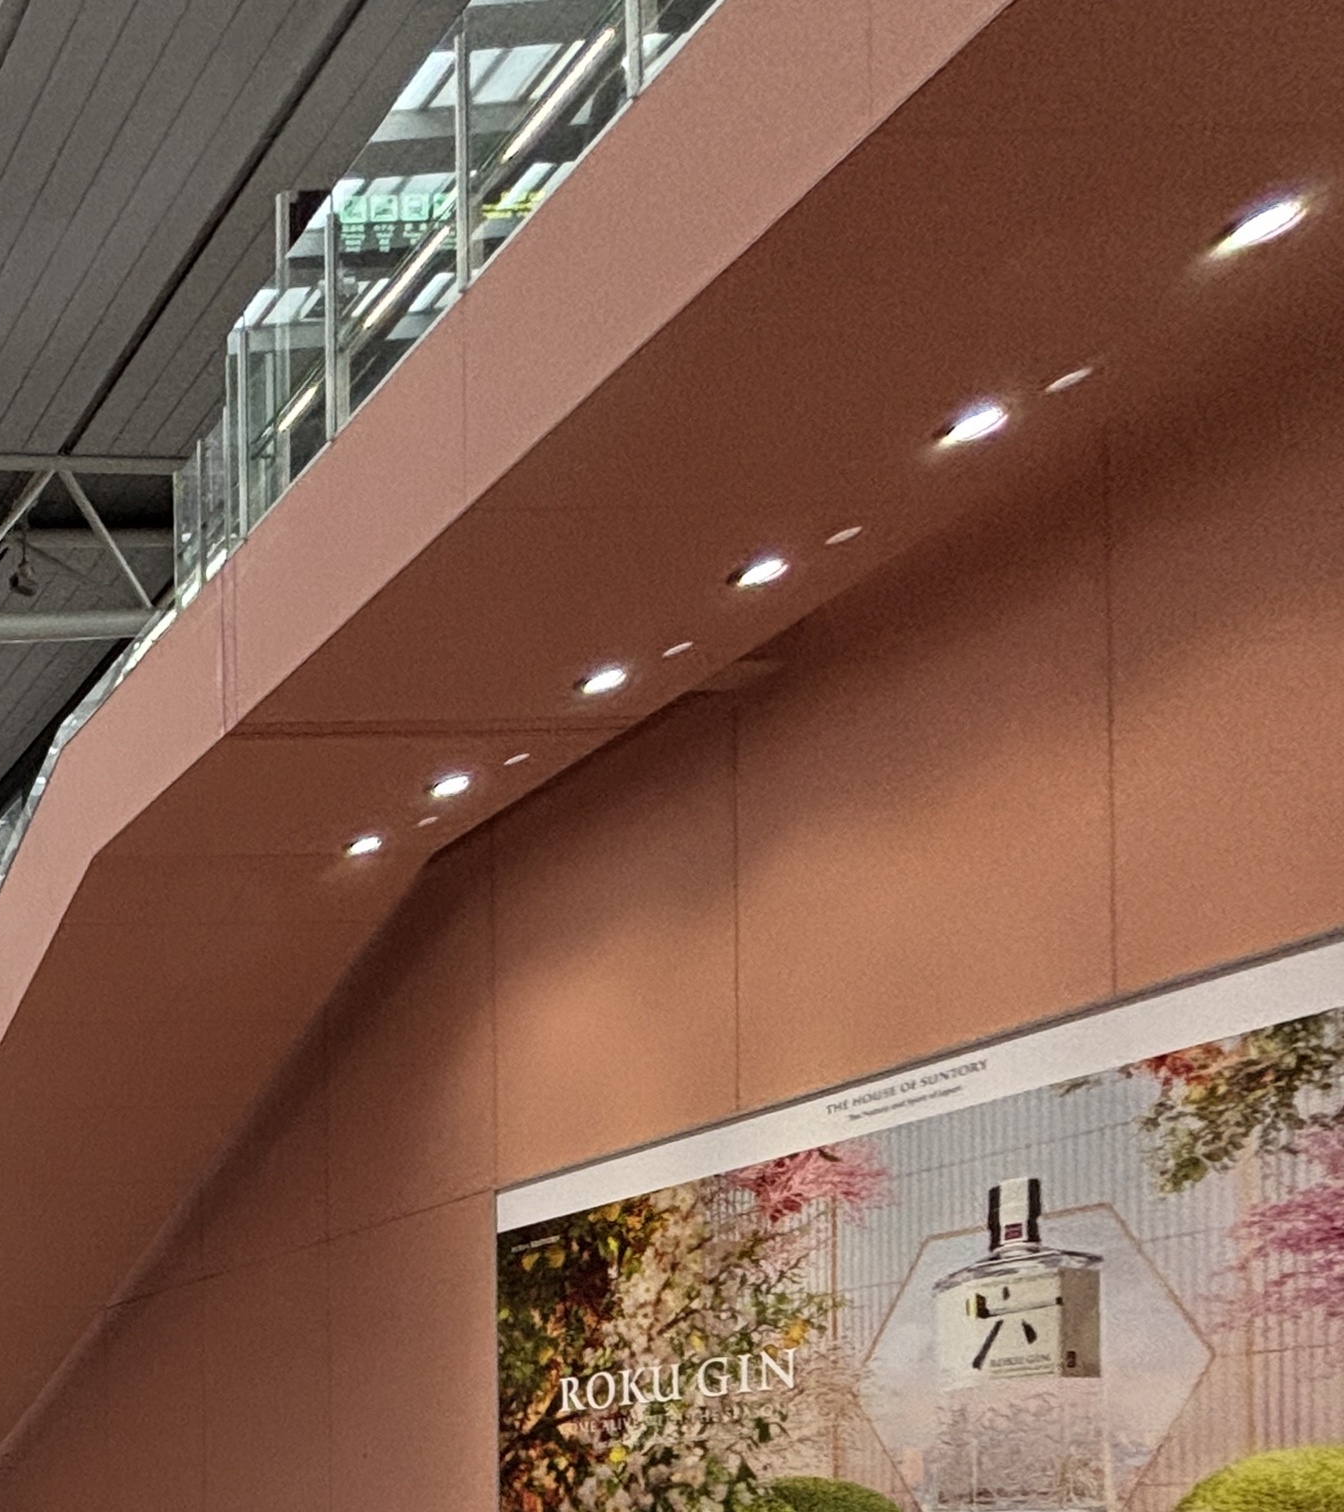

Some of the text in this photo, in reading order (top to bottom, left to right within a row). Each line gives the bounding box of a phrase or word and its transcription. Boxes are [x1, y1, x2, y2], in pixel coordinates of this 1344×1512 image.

[826, 1059, 988, 1115] THE HOUSE OF SUNTORY
[559, 1362, 682, 1413] ROKU
[697, 1347, 797, 1398] GIN
